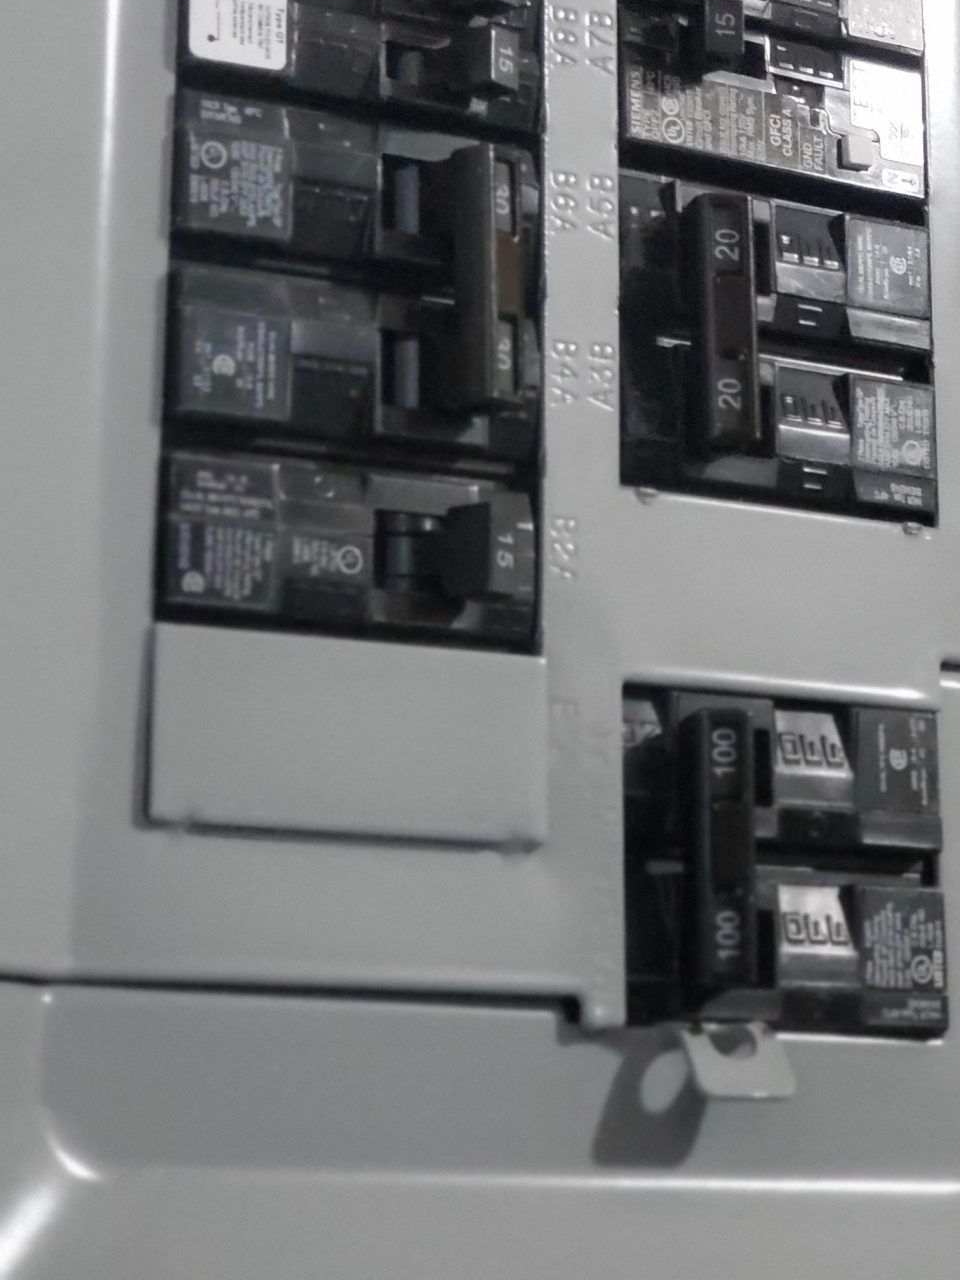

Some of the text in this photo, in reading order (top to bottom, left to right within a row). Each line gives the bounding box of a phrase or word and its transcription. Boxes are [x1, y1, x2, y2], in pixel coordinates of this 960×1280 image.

[715, 11, 735, 37] 15
[497, 44, 514, 73] 15
[630, 70, 641, 133] SIEMENS
[769, 113, 782, 146] GFCI
[782, 108, 793, 157] CLASS A
[801, 142, 813, 168] GND
[813, 135, 824, 171] FAULT
[715, 228, 740, 261] 20
[717, 378, 742, 411] 20
[497, 533, 515, 568] 15
[711, 727, 737, 778] 100
[715, 909, 740, 960] 100
